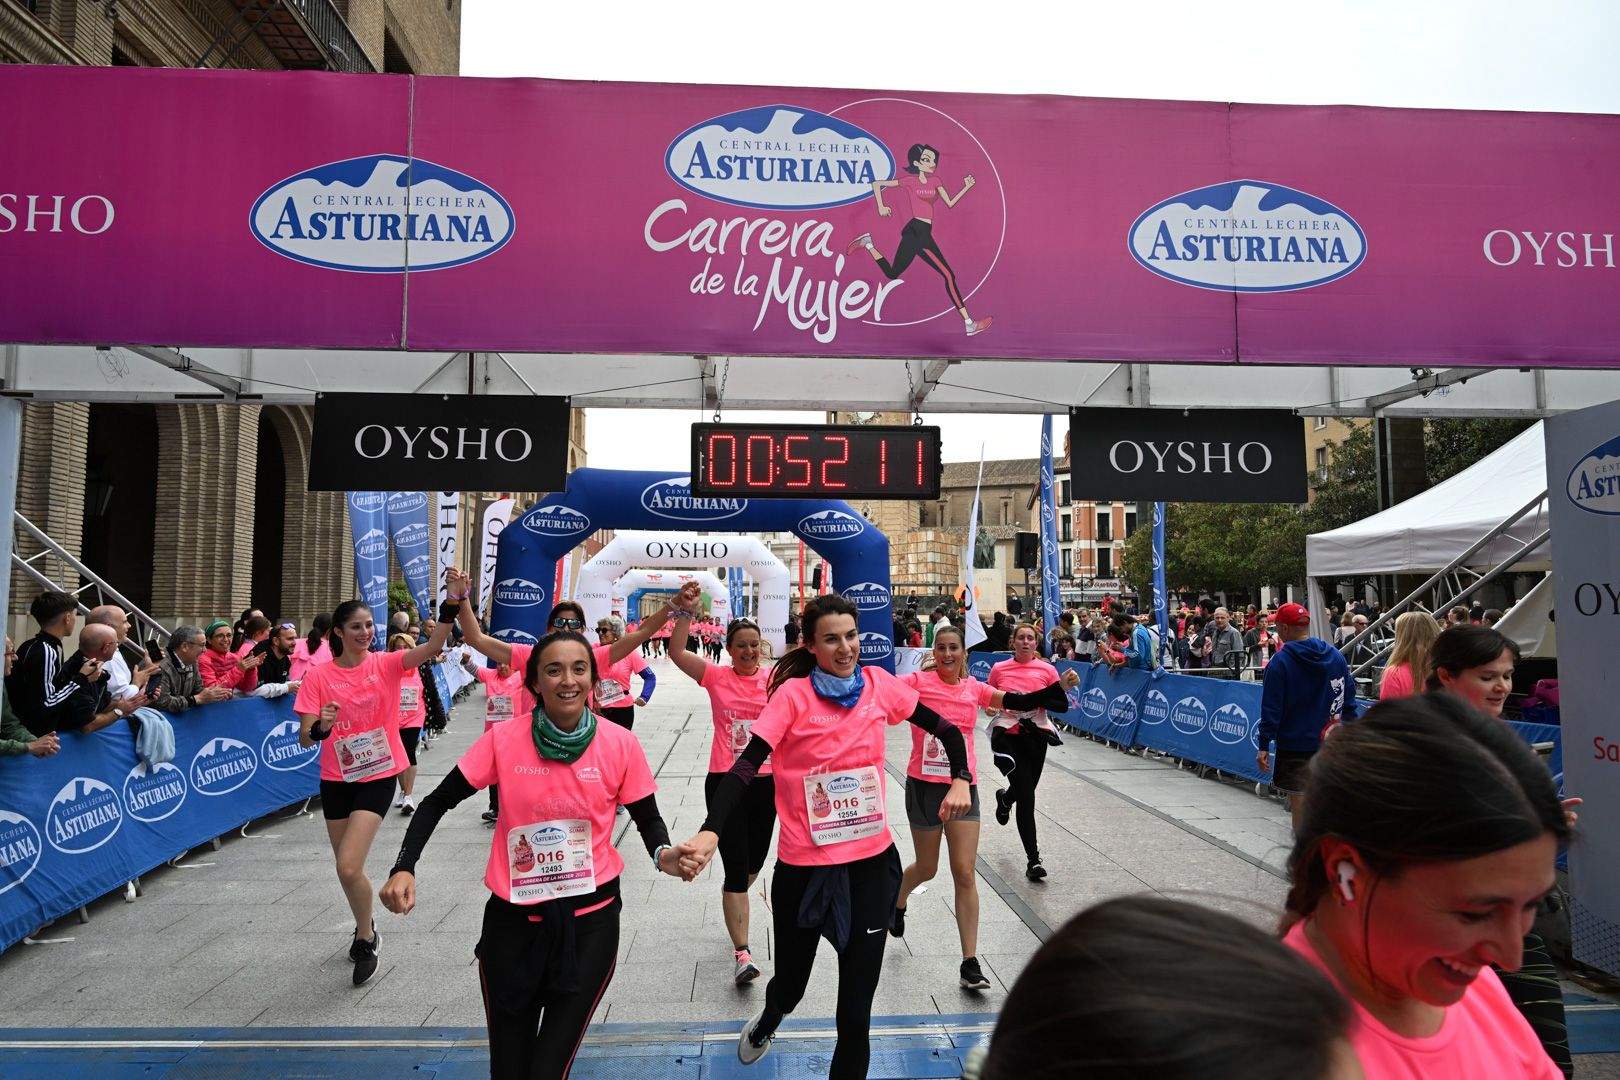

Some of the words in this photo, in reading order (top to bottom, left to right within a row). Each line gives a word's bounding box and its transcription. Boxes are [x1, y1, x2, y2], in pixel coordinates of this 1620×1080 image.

[719, 140, 792, 151] CENTRAL
[799, 143, 871, 154] LECHERA
[683, 140, 876, 184] ASTURIANA
[313, 194, 394, 207] CENTRAL
[403, 196, 487, 208] LECHERA
[269, 196, 495, 243] ASTURIANA
[1184, 218, 1259, 229] CENTRAL
[1266, 219, 1341, 231] LECHERA
[644, 198, 834, 258] Carrera
[1147, 219, 1350, 264] ASTURIANA
[689, 257, 726, 296] de
[733, 256, 760, 297] la
[751, 254, 905, 344] Mujer
[354, 424, 533, 463] OYSHO
[1109, 439, 1273, 475] OYSHO
[649, 489, 740, 510] ASTURIANA
[526, 514, 585, 530] ASTURIANA
[803, 521, 860, 534] ASTURIANA
[646, 541, 729, 559] OYSHO
[750, 559, 776, 567] OYSHO
[1172, 707, 1204, 728] ASTURIANA
[1210, 715, 1245, 738] ASTURIANA
[354, 749, 373, 760] 016
[196, 756, 255, 788] ASTURIANA
[514, 765, 551, 776] OYSHO
[129, 780, 184, 812] ASTURIANA
[833, 797, 859, 810] 016
[54, 801, 121, 844] ASTURIANA
[838, 810, 858, 819] 12554
[0, 825, 28, 841] ECHERA
[533, 833, 565, 843] ASTURIANA
[818, 831, 842, 840] OYSHO
[537, 850, 565, 864] 016
[541, 864, 563, 874] 12493
[519, 877, 542, 885] CARRERA
[517, 887, 544, 897] OYSHO
